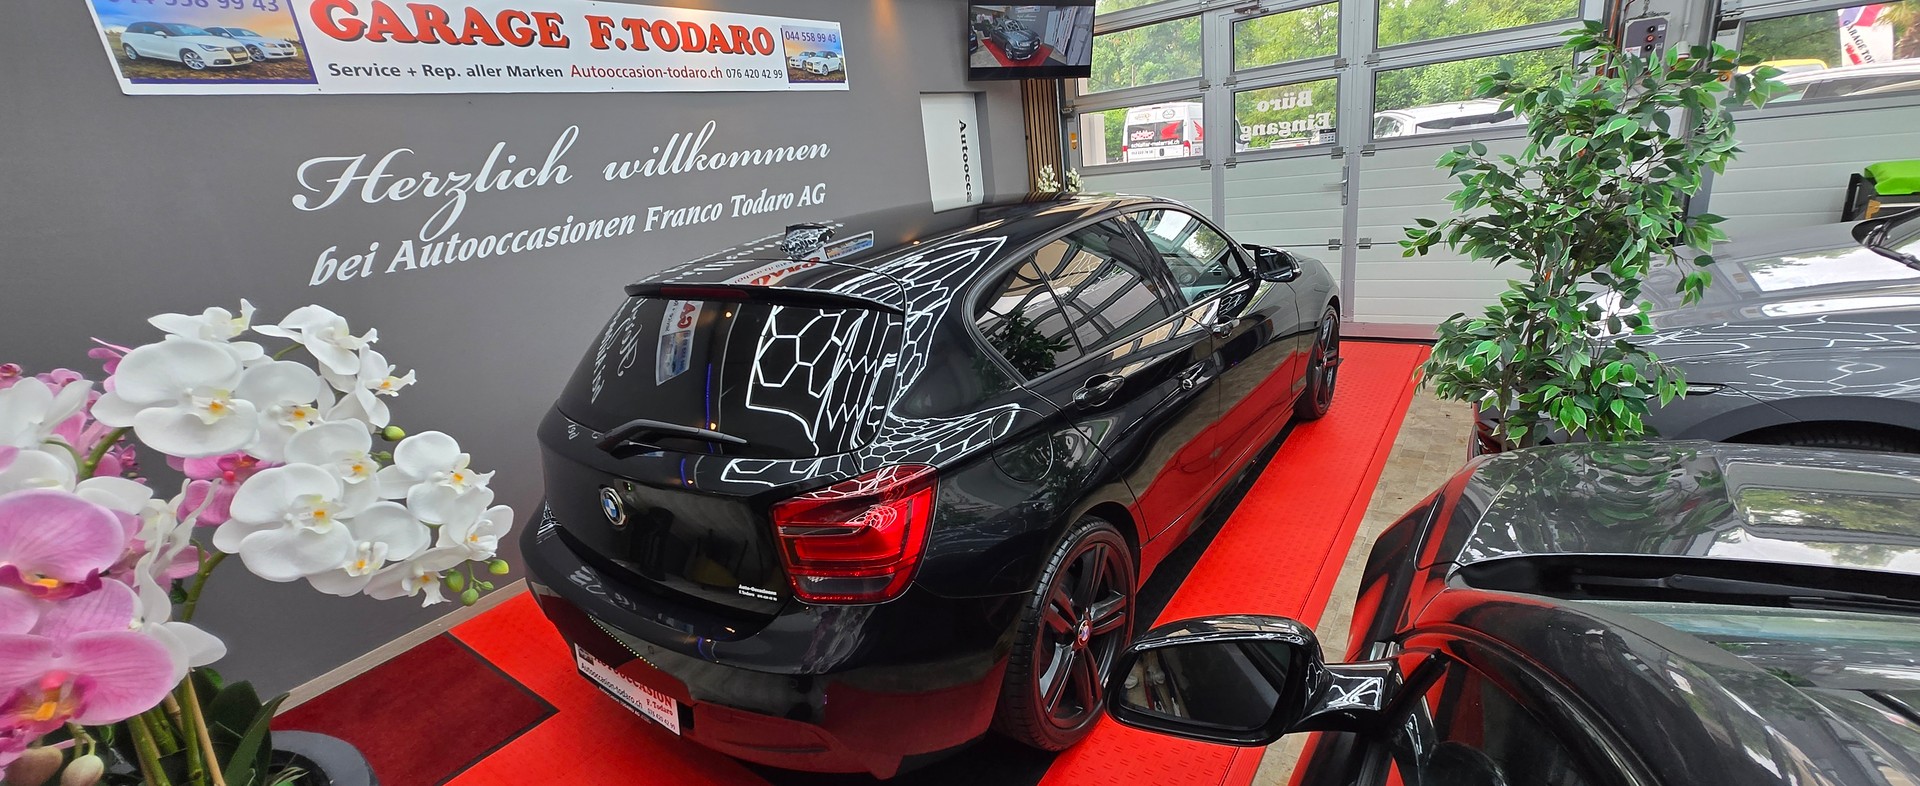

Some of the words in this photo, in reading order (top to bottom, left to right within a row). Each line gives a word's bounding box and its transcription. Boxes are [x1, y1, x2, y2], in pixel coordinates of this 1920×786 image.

[252, 0, 279, 12] 43
[310, 0, 570, 49] GARAGE
[585, 14, 775, 56] F.TODARO
[785, 31, 800, 41] 044
[801, 32, 816, 42] 558
[817, 33, 827, 43] 99
[828, 33, 837, 43] 43
[1842, 20, 1867, 51] GARAGE
[328, 63, 401, 77] Service
[422, 64, 462, 80] Rep.
[466, 64, 502, 77] aller
[507, 65, 563, 78] Marken
[571, 65, 723, 79] Autooccasion-todaro.ch
[726, 70, 742, 79] 076
[744, 69, 760, 79] 420
[762, 70, 772, 79] 42
[773, 70, 783, 79] 99
[291, 124, 579, 242] Herzlich
[602, 119, 831, 182] willkommen
[308, 241, 380, 286] bei
[385, 211, 637, 274] Autooccasionen
[643, 201, 723, 233] Franco
[730, 188, 795, 219] Todaro
[796, 182, 827, 208] AG
